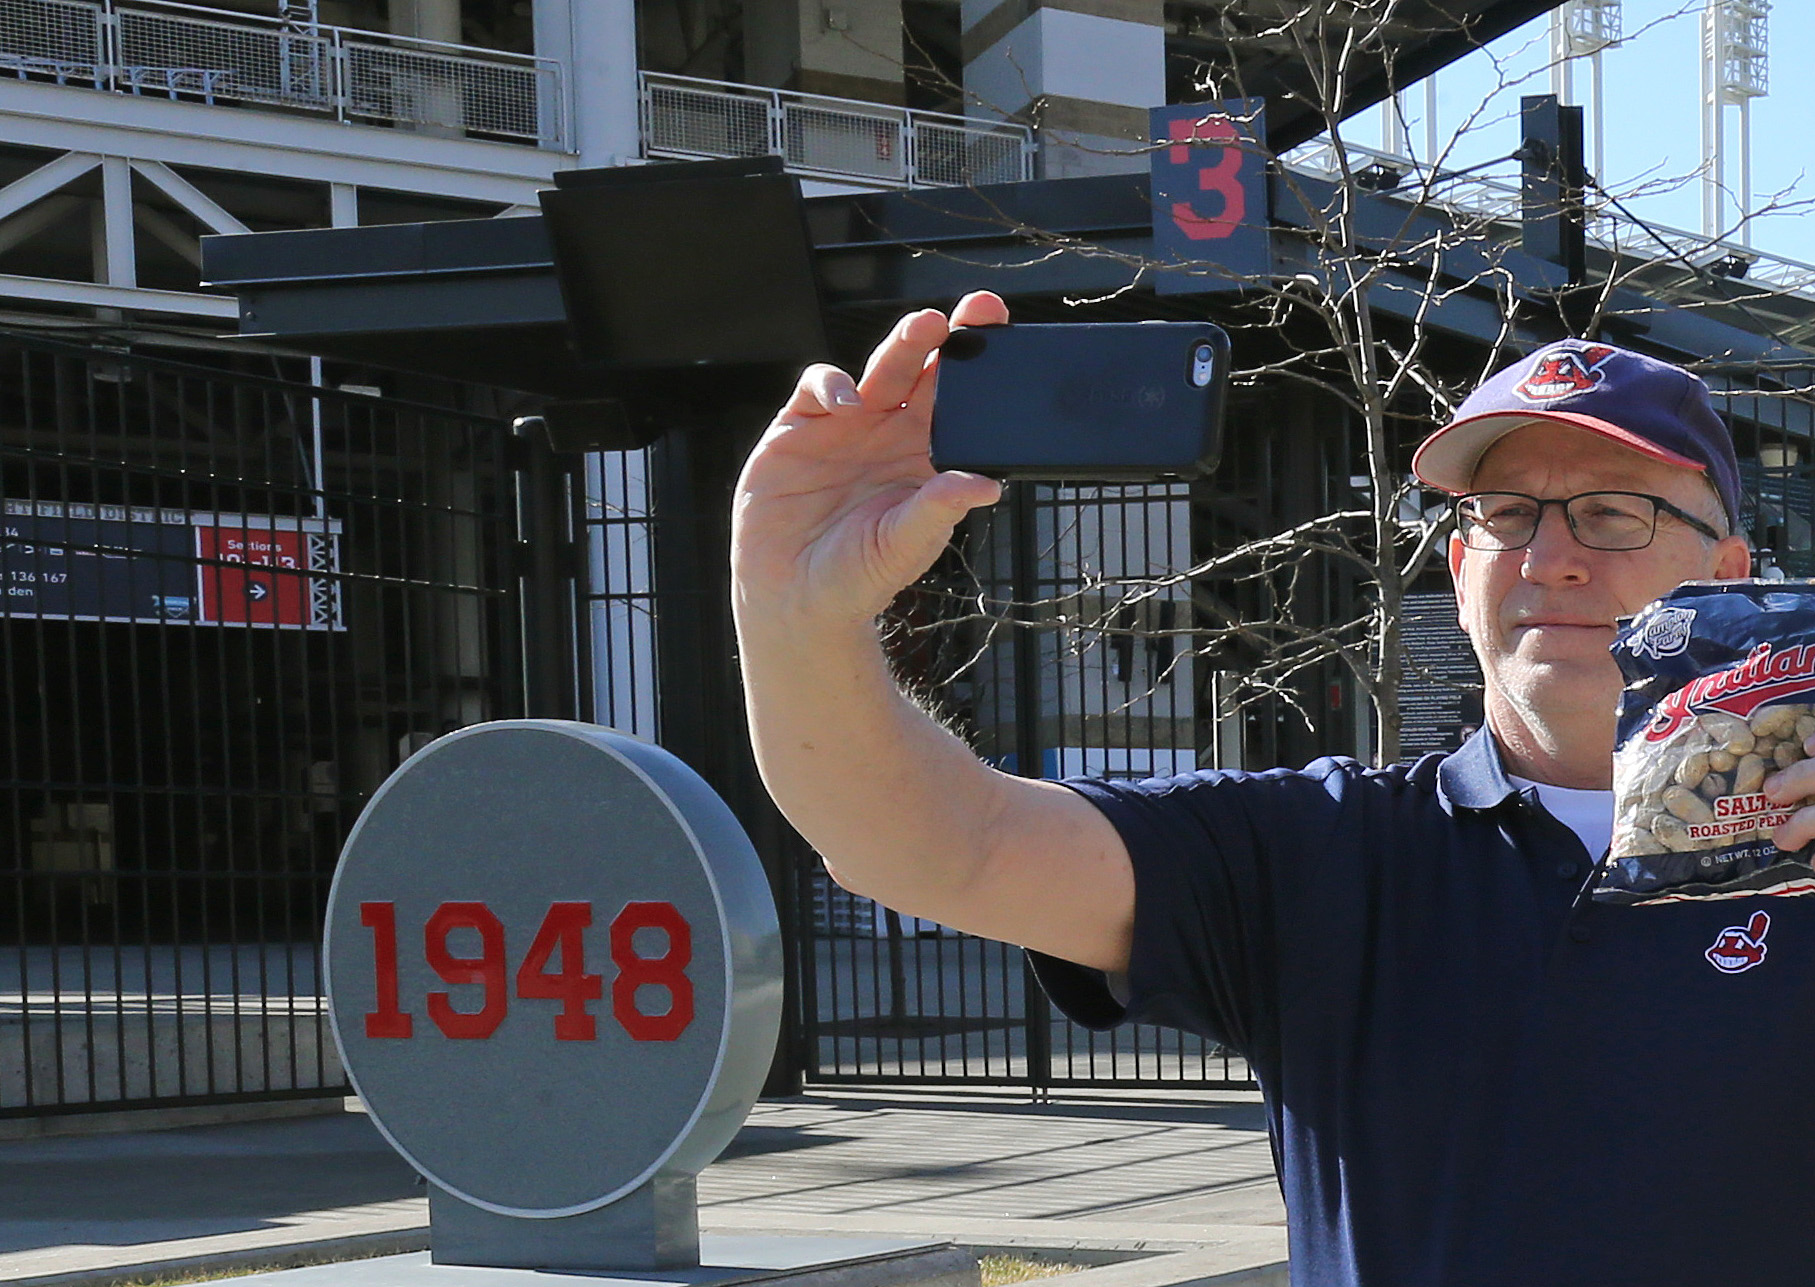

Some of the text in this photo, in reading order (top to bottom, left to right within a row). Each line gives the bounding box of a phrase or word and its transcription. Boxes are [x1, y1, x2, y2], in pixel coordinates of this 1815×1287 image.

[1169, 118, 1246, 240] 3
[42, 572, 68, 584] 167
[1627, 608, 1694, 656] Hampton
[1648, 620, 1689, 656] Farms
[1716, 794, 1793, 817] SALT
[1690, 818, 1756, 838] ROASTED
[1714, 852, 1734, 864] NET
[360, 902, 695, 1042] 1948
